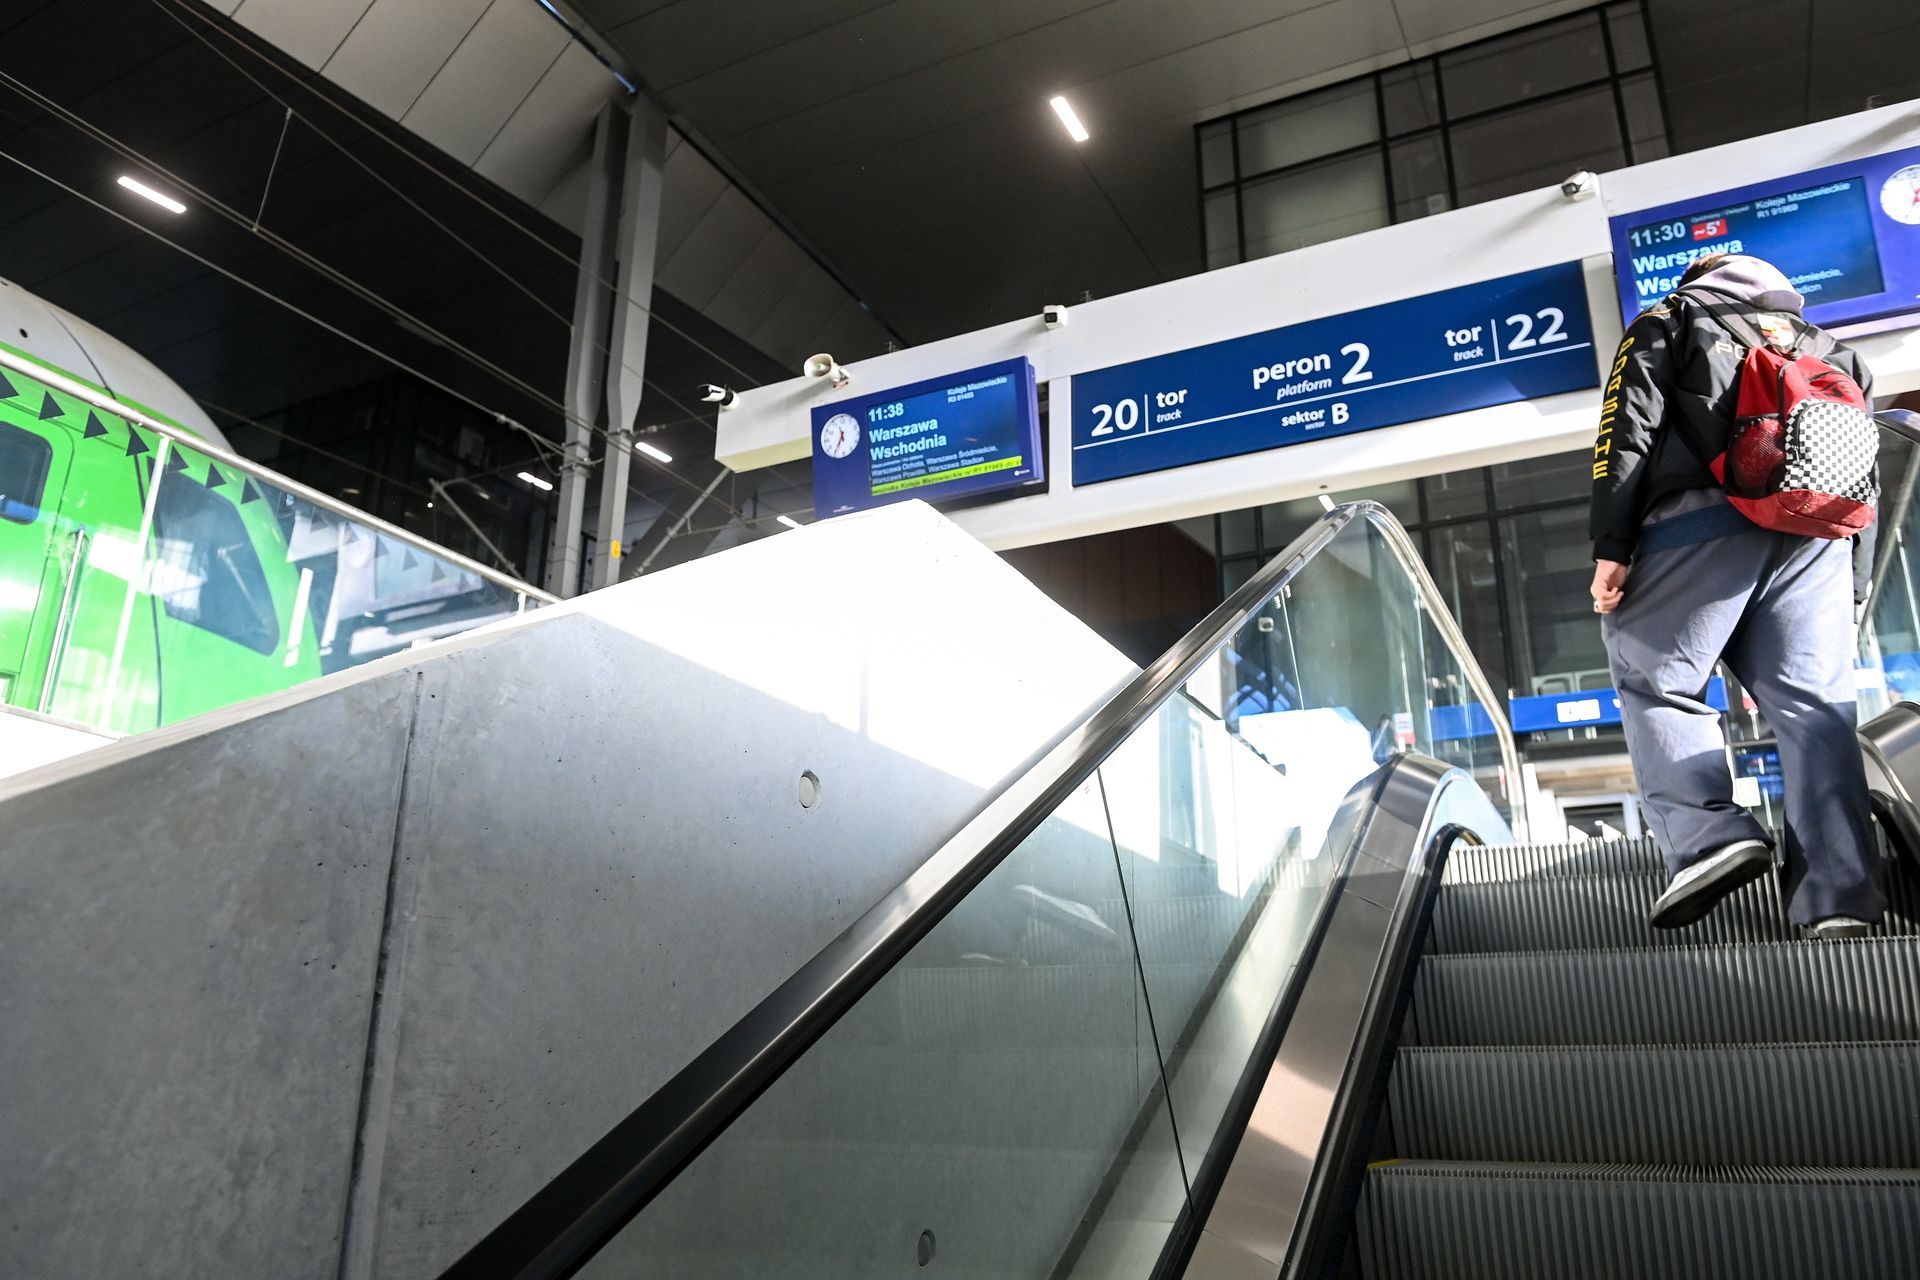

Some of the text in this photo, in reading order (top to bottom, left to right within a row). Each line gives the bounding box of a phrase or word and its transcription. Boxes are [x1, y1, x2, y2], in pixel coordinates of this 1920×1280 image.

[1630, 221, 1686, 248] 11:30
[1632, 239, 1744, 275] Warszawa
[1444, 306, 1568, 351] tor 22
[1252, 342, 1373, 390] peron 2
[1453, 345, 1484, 362] track
[1276, 378, 1332, 401] platform
[868, 403, 904, 422] 11:38
[1091, 389, 1187, 437] 20 tor
[1156, 408, 1182, 423] track
[1281, 402, 1350, 427] sektor B
[1592, 336, 1635, 480] PORSCHE
[868, 417, 938, 443] Warszawa
[869, 434, 947, 461] Wschodnia
